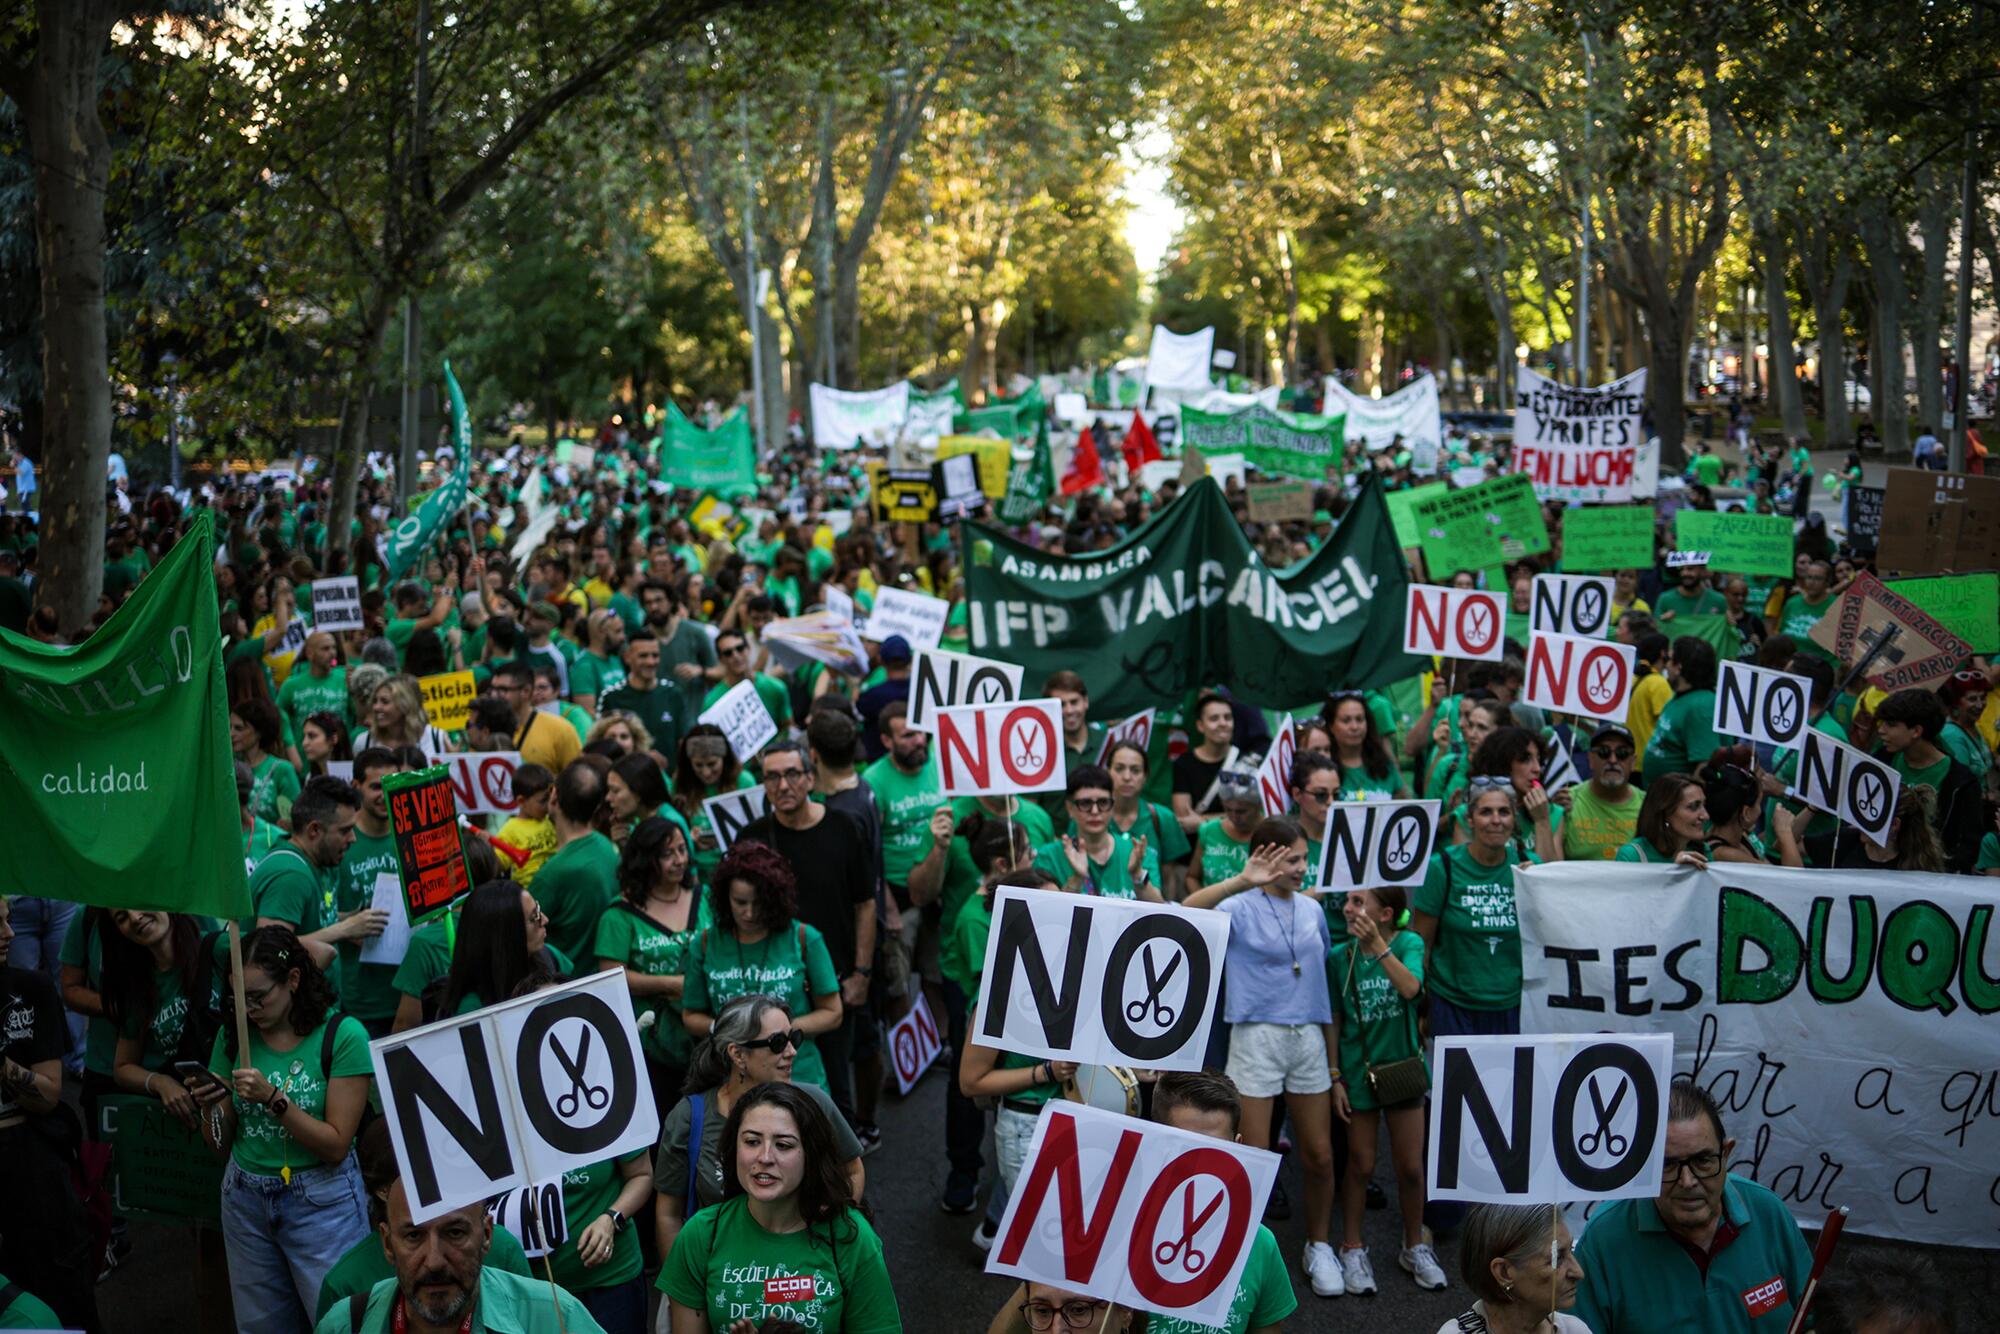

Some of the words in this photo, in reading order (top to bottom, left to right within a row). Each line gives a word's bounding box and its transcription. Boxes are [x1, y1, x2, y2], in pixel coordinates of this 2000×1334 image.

[1557, 447, 1636, 487] LUCHA
[1002, 545, 1152, 582] ASAMBLEA
[970, 600, 1069, 648] IFP
[1409, 589, 1500, 655] NO
[1534, 578, 1608, 635] NO
[914, 654, 1012, 727] NO
[1528, 636, 1627, 715] NO
[1883, 655, 1954, 689] SALARIO
[1718, 665, 1805, 743] NO
[938, 705, 1058, 791] NO
[42, 761, 149, 793] calidad
[431, 757, 517, 810] NO
[1799, 732, 1894, 833] NO
[393, 793, 413, 834] SE
[1321, 804, 1431, 889] NO
[1482, 914, 1517, 928] RIVAS
[982, 896, 1212, 1061] NO
[1544, 938, 1705, 1017] IES
[382, 991, 638, 1209] NO
[1436, 1041, 1660, 1193] NO
[1854, 1067, 1904, 1115] a
[520, 1182, 565, 1250] NO
[996, 1110, 1253, 1309] NO
[1894, 1165, 1938, 1215] a
[730, 1302, 753, 1319] DE
[767, 1278, 811, 1293] CCOO
[1744, 1279, 1784, 1306] CCOO
